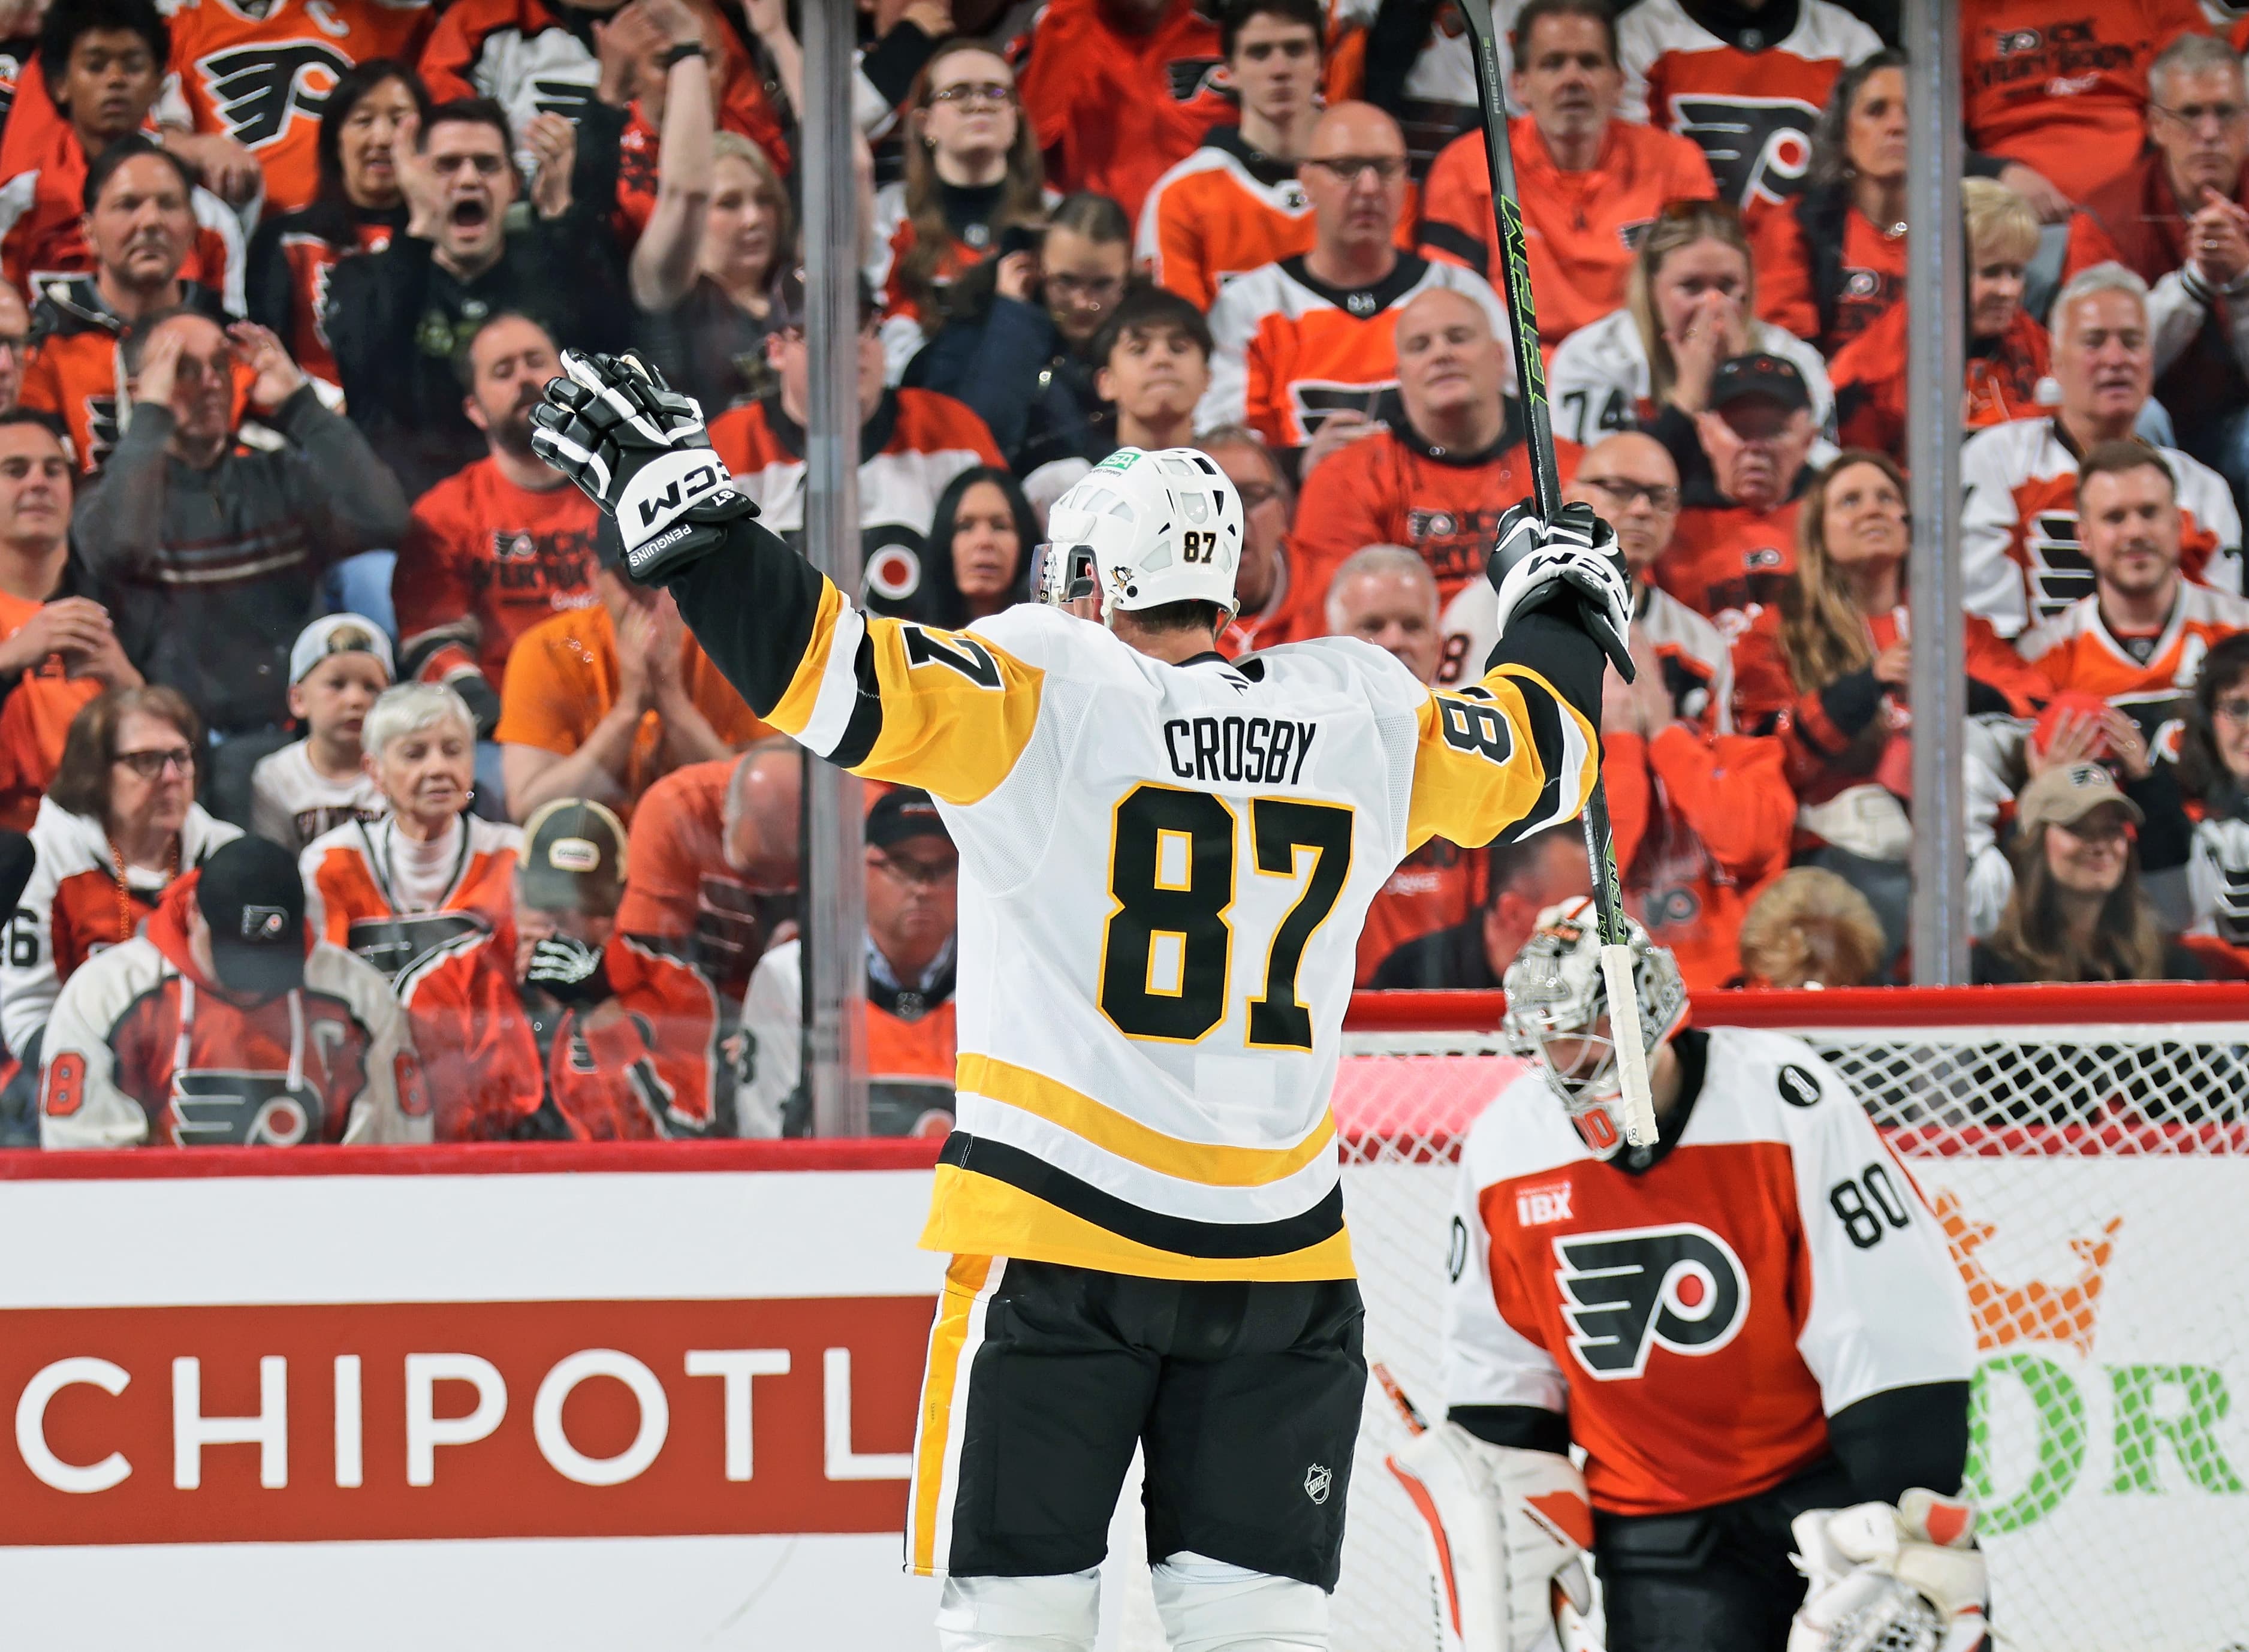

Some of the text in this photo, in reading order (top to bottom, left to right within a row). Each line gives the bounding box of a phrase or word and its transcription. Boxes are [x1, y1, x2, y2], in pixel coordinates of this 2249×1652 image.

[1563, 387, 1627, 444] 74
[712, 489, 735, 507] 87
[629, 523, 693, 567] PENGUINS
[1183, 530, 1216, 564] 87
[1163, 716, 1316, 785] CROSBY
[1096, 779, 1356, 1054] 87
[1606, 857, 1627, 937] CCM
[0, 909, 38, 967] 6
[40, 1050, 88, 1117] 8
[1516, 1192, 1574, 1227] IBX
[1831, 1163, 1909, 1248] 80
[15, 1347, 914, 1494] CHIPOTL
[1309, 1476, 1326, 1493] NHL
